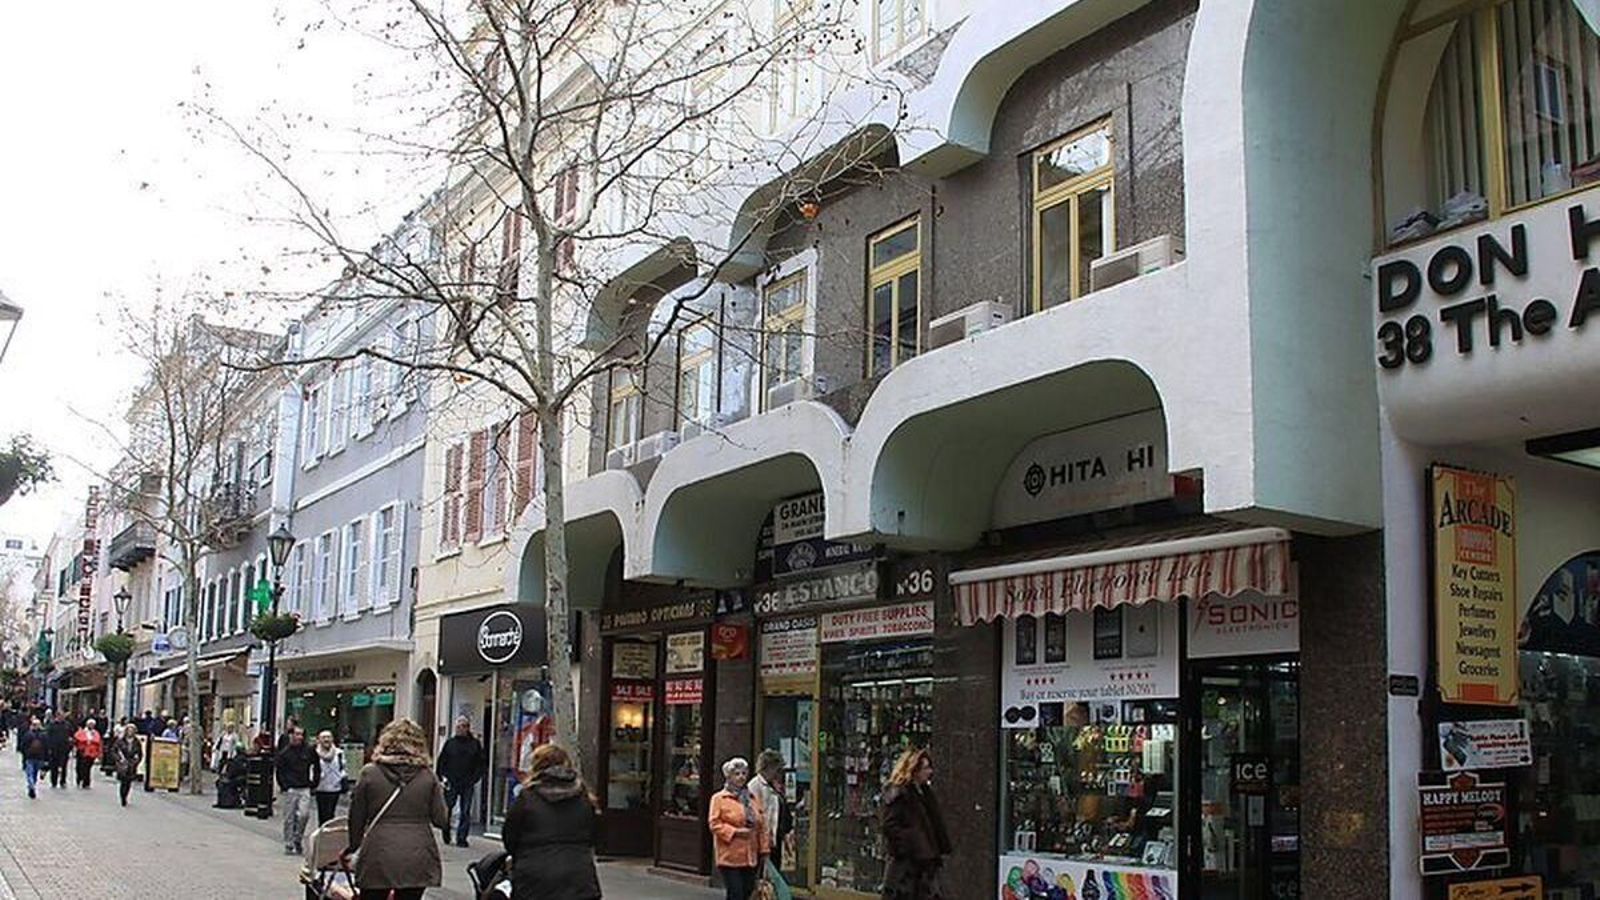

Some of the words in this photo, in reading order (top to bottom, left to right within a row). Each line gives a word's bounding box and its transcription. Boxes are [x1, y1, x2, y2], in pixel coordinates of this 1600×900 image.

[1378, 223, 1529, 313] DON
[1377, 314, 1433, 369] 38
[1440, 294, 1557, 354] The
[1440, 490, 1512, 538] ARCADE
[1449, 582, 1470, 598] Shoe
[1472, 585, 1503, 601] Repairs
[832, 613, 854, 627] DUTY
[857, 610, 880, 623] FREE
[882, 604, 928, 621] SUPPLIES
[1208, 600, 1298, 626] SONIC
[1458, 602, 1497, 620] Perfumes
[1459, 622, 1497, 641] Jewellery
[1459, 660, 1500, 677] Groceries
[1235, 763, 1268, 780] ice
[1422, 791, 1459, 806] HAPPY
